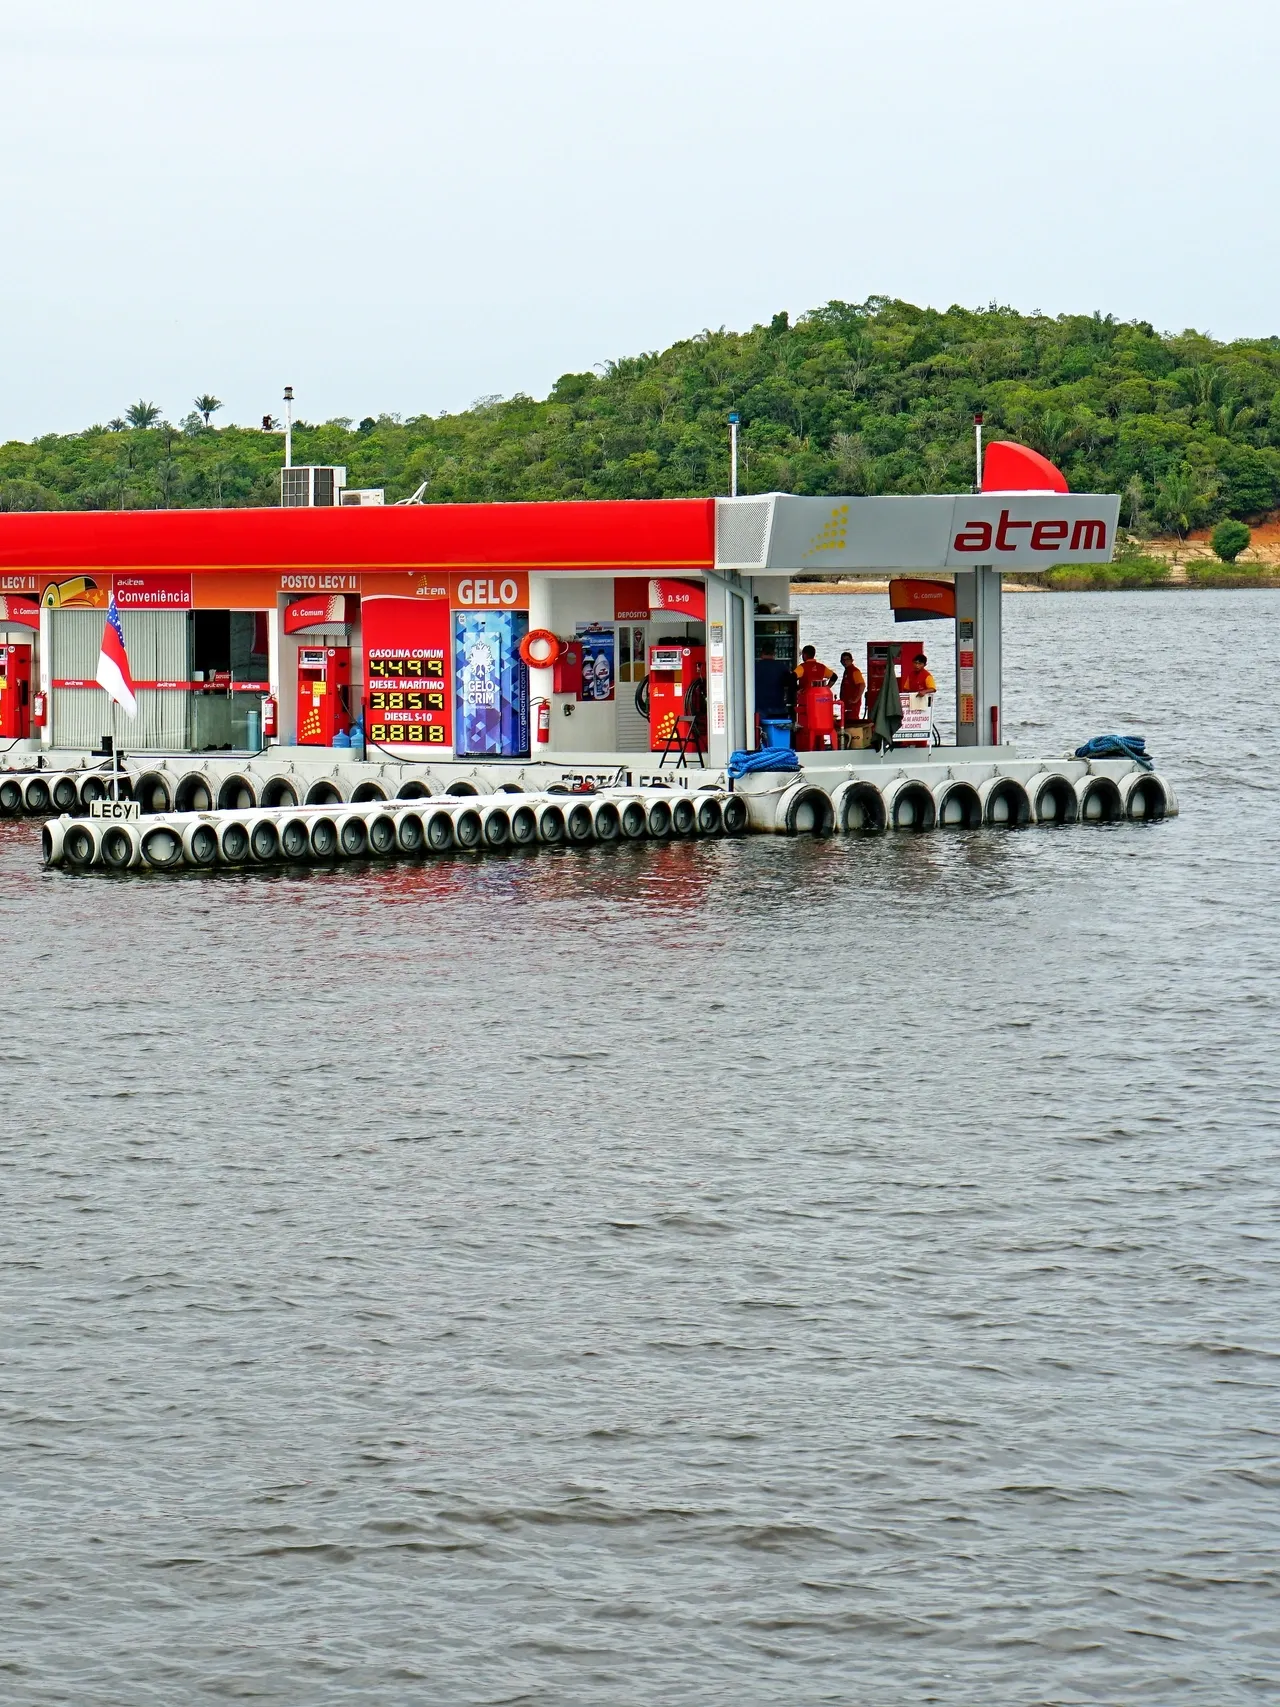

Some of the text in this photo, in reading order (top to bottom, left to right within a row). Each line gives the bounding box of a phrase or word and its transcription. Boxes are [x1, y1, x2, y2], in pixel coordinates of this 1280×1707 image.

[954, 510, 1106, 551] atem
[2, 577, 25, 588] LECY
[28, 577, 35, 588] II
[281, 575, 356, 588] POSTO LECY II
[117, 590, 190, 602] Conveniência
[416, 586, 446, 595] atem
[457, 579, 518, 605] GELO
[292, 609, 298, 617] G.
[369, 649, 443, 658] GASOLINA COMUM
[370, 680, 444, 690] DIESEL MARÍTIMO
[469, 681, 494, 692] GELO
[469, 693, 494, 704] CRIM
[384, 713, 432, 722] DIESEL S-10
[92, 803, 132, 819] LECY
